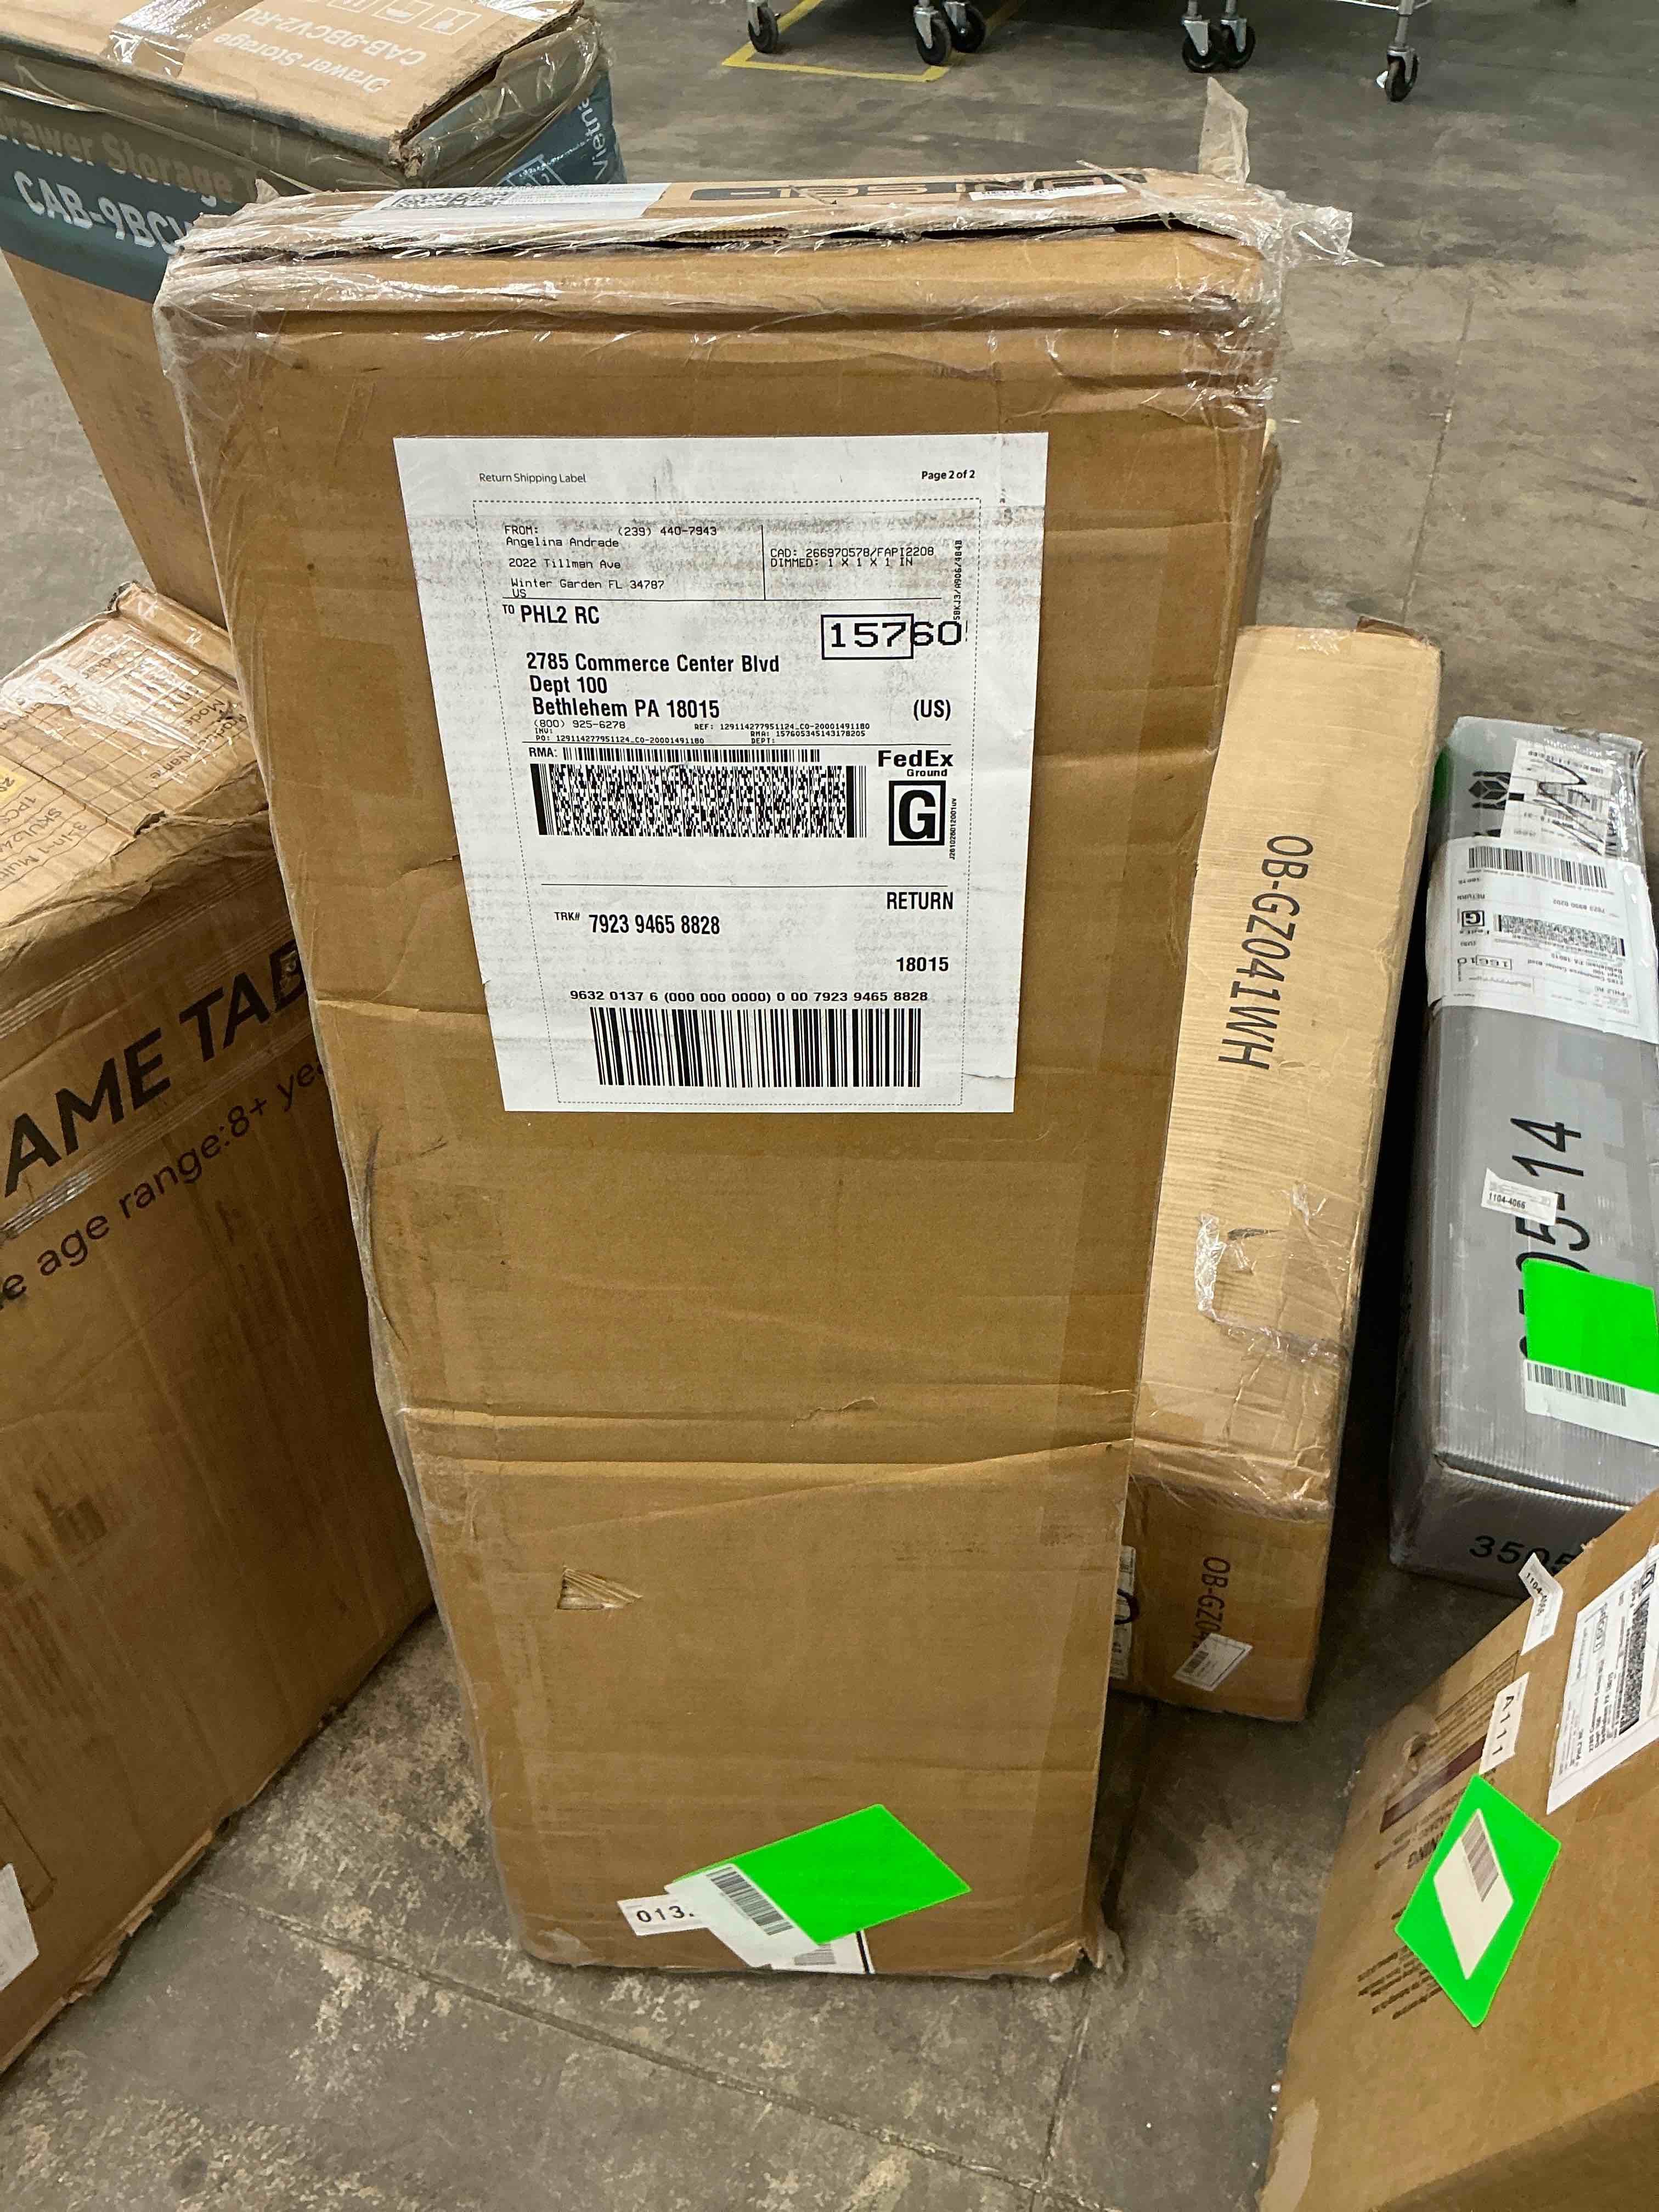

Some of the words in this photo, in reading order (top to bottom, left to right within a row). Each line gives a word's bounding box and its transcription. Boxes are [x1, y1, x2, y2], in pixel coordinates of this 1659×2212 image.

[214, 33, 303, 66] Storage
[301, 58, 391, 93] Drawer
[479, 472, 511, 482] Return
[514, 472, 557, 484] Shipping
[560, 473, 586, 483] Label
[921, 471, 947, 481] Page
[949, 471, 955, 479] 2
[956, 470, 968, 479] of
[969, 470, 975, 479] 2
[505, 525, 538, 535] FROM:
[618, 526, 651, 537] (239)
[660, 526, 717, 536] 440-7943
[506, 537, 563, 548] Angelina
[569, 538, 619, 548] Andrade
[770, 549, 798, 558] CAD:
[509, 558, 537, 568] 2022
[544, 559, 593, 569] Tillman
[600, 560, 621, 569] Ave
[771, 558, 819, 568] DIMMED:
[828, 558, 833, 567] 1
[842, 558, 849, 567] X
[857, 558, 862, 567] 1
[870, 558, 877, 567] X
[885, 558, 891, 567] 1
[899, 557, 913, 567] IN
[511, 579, 553, 589] Winter
[560, 579, 602, 589] Garden
[608, 580, 623, 590] FL
[629, 580, 664, 590] 34787
[512, 589, 527, 598] US
[503, 605, 515, 615] TO
[521, 605, 567, 624] PHL2
[575, 606, 600, 624] RC
[831, 620, 962, 648] 15760
[527, 652, 568, 670] 2785
[575, 653, 669, 672] Commerce
[676, 654, 734, 672] Center
[741, 654, 780, 672] Blvd
[530, 675, 571, 696] Dept
[577, 676, 608, 694] 100
[533, 697, 628, 717] Bethlehem
[635, 699, 660, 718] PA
[666, 699, 720, 718] 18015
[913, 699, 951, 721] (US)
[534, 719, 565, 729] (800)
[572, 720, 626, 730] 925-6278
[529, 747, 558, 758] RMA:
[878, 749, 954, 767] FedEx
[906, 769, 948, 777] Ground
[899, 789, 936, 839] G
[887, 891, 953, 910] RETURN
[554, 911, 580, 922] TRK#
[589, 914, 630, 933] 7923
[635, 915, 675, 934] 9465
[681, 915, 720, 935] 8828
[1218, 835, 1314, 1070] OB-GZ041WH
[895, 956, 949, 972] 18015
[569, 990, 604, 1001] 9632
[610, 991, 644, 1001] 0137
[650, 991, 658, 1001] 6
[664, 991, 695, 1004] (000
[700, 992, 726, 1002] 000
[731, 992, 771, 1003] 0000)
[777, 992, 786, 1002] 0
[791, 992, 808, 1002] 00
[814, 991, 848, 1002] 7923
[853, 991, 888, 1002] 9465
[893, 991, 928, 1001] 8828
[37, 1214, 110, 1276] age
[1491, 1694, 1516, 1757] A111
